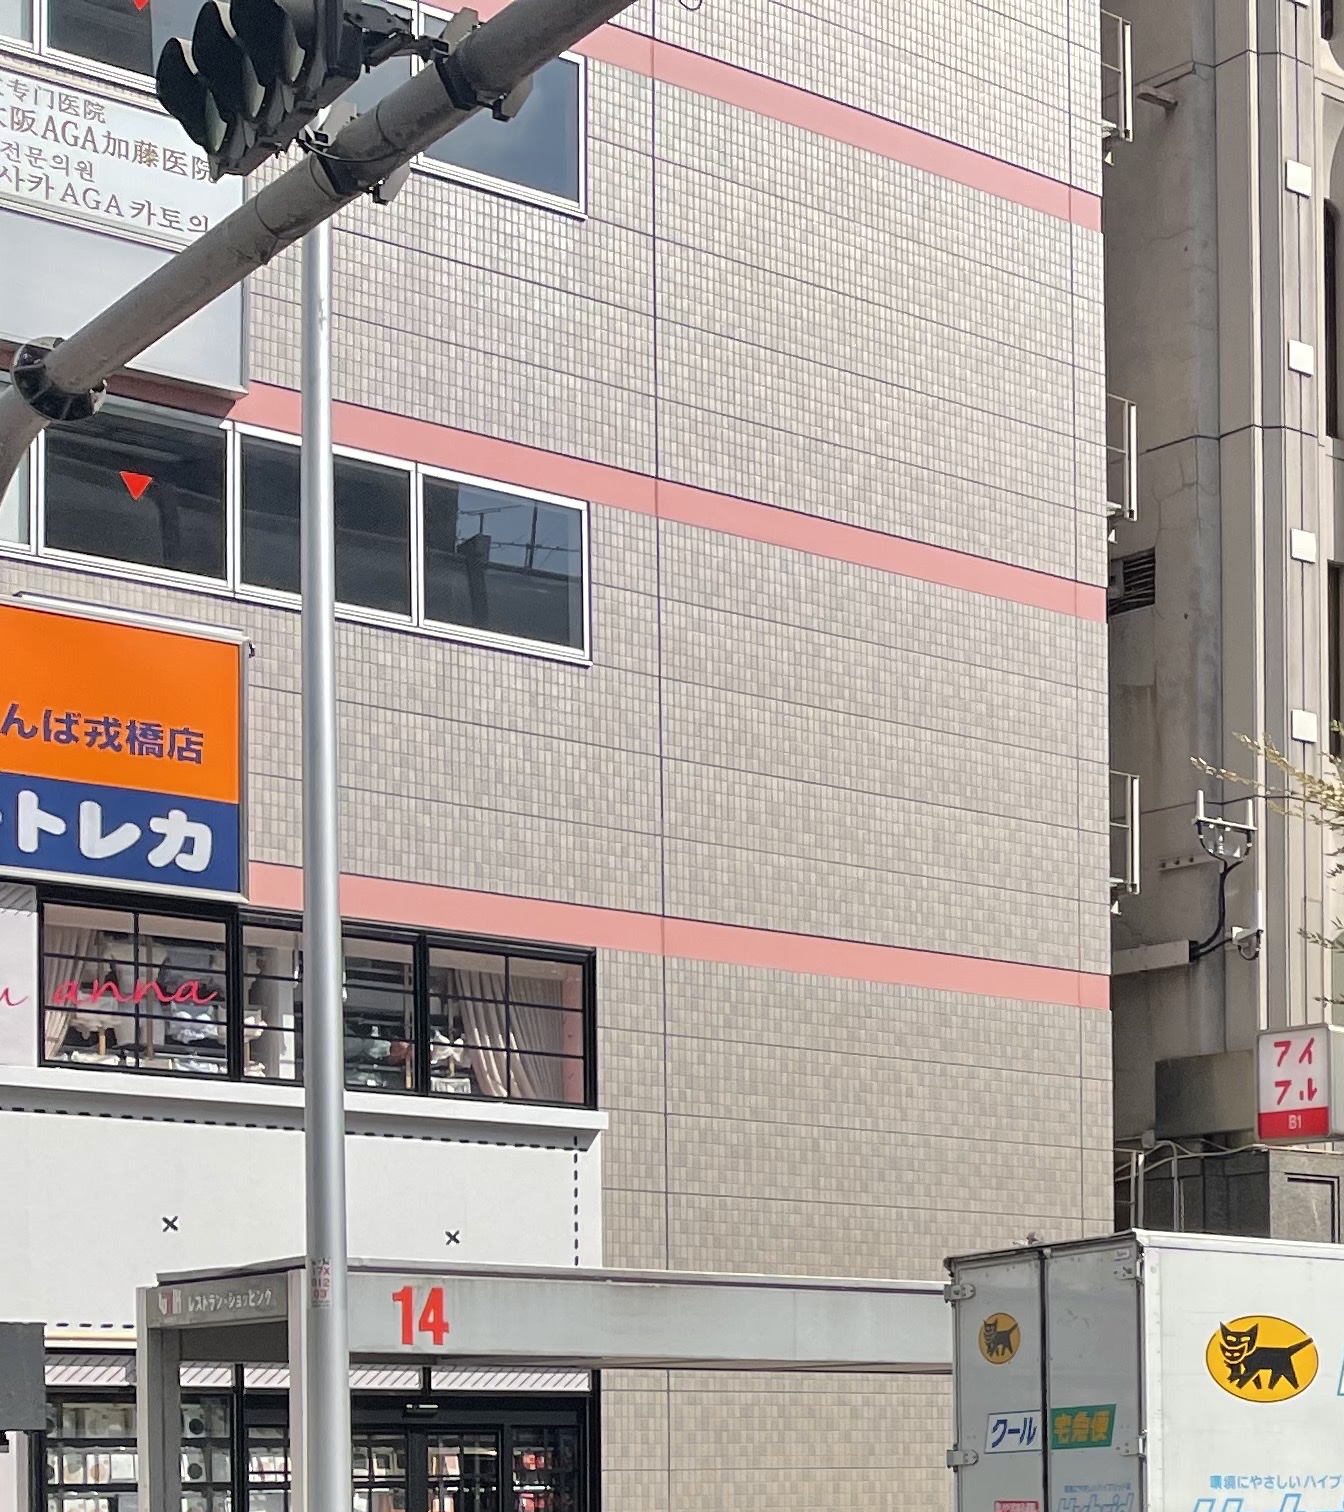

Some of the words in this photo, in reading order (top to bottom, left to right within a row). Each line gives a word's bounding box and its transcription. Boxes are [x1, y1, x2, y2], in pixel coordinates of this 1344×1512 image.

[0, 77, 106, 124] 专门医院
[0, 790, 213, 872] トレカ
[53, 978, 218, 1004] anna
[1273, 1037, 1315, 1068] アイ
[1288, 1114, 1302, 1130] B1
[392, 1285, 450, 1346] 14
[991, 1416, 1038, 1449] クール
